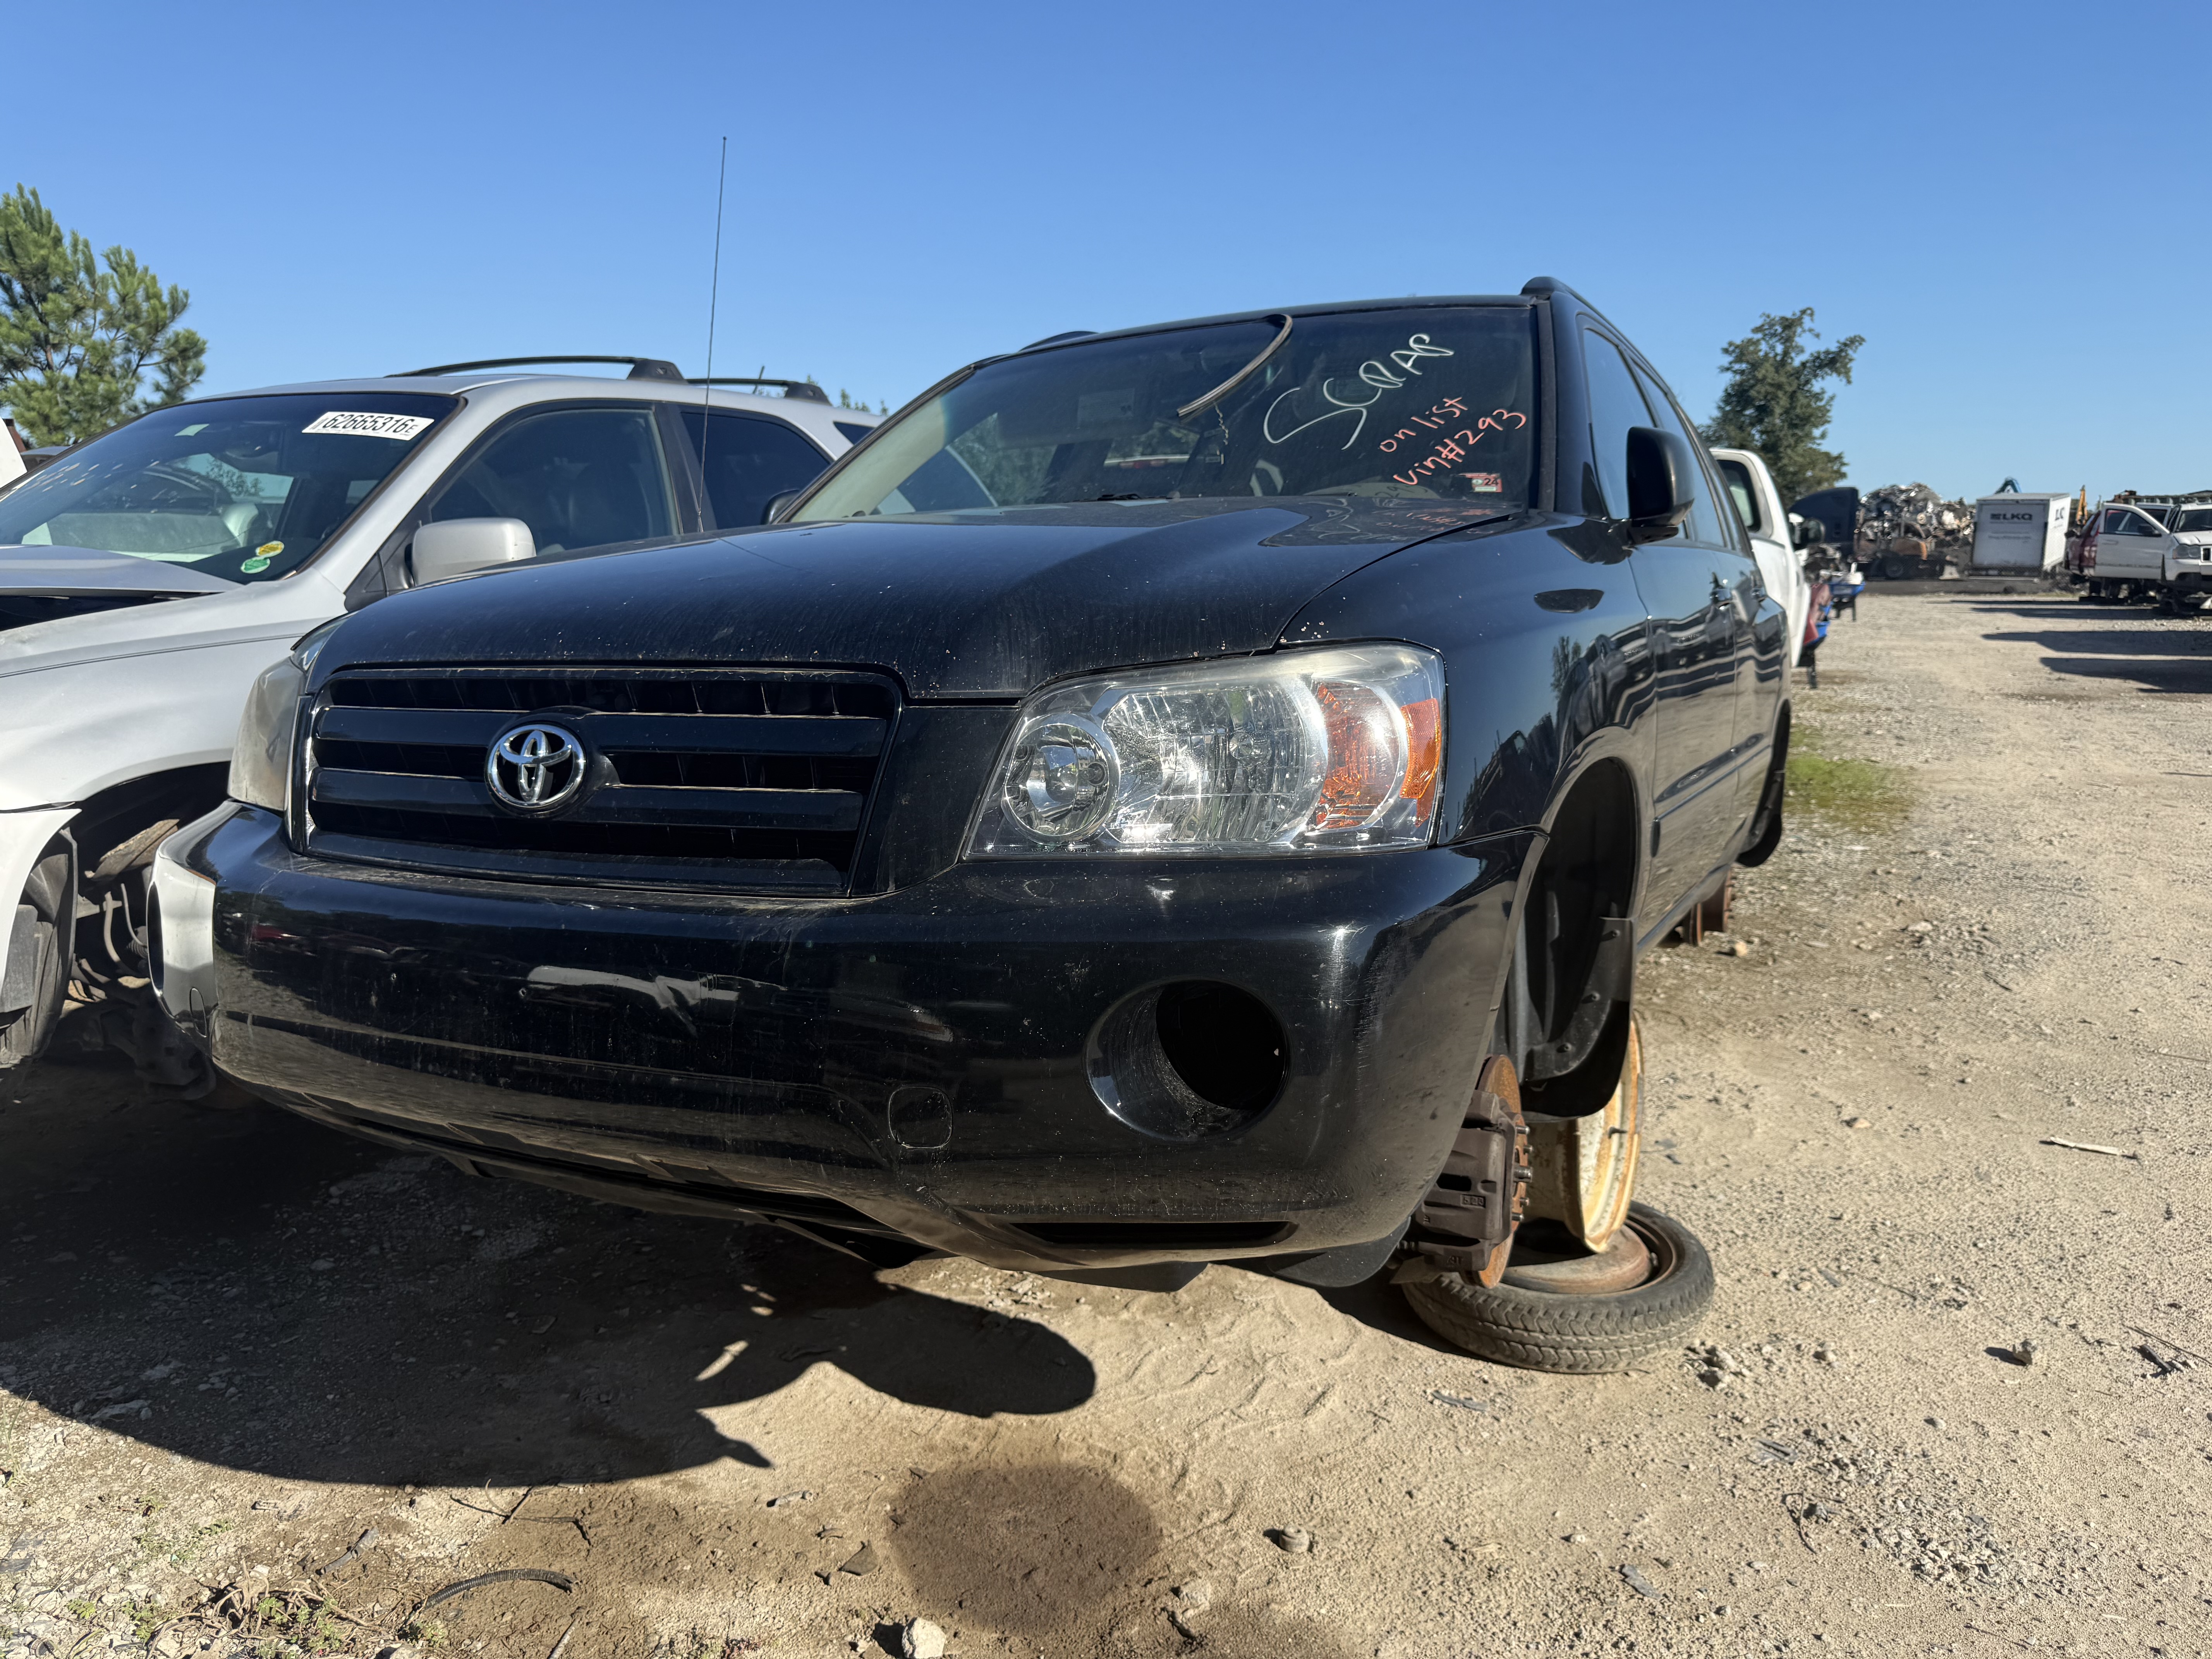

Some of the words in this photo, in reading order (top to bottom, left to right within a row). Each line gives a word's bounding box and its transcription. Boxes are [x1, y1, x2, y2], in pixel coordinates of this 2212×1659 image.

[1263, 333, 1455, 450] SCRAP
[1379, 429, 1416, 453] on
[1484, 477, 1499, 486] 24
